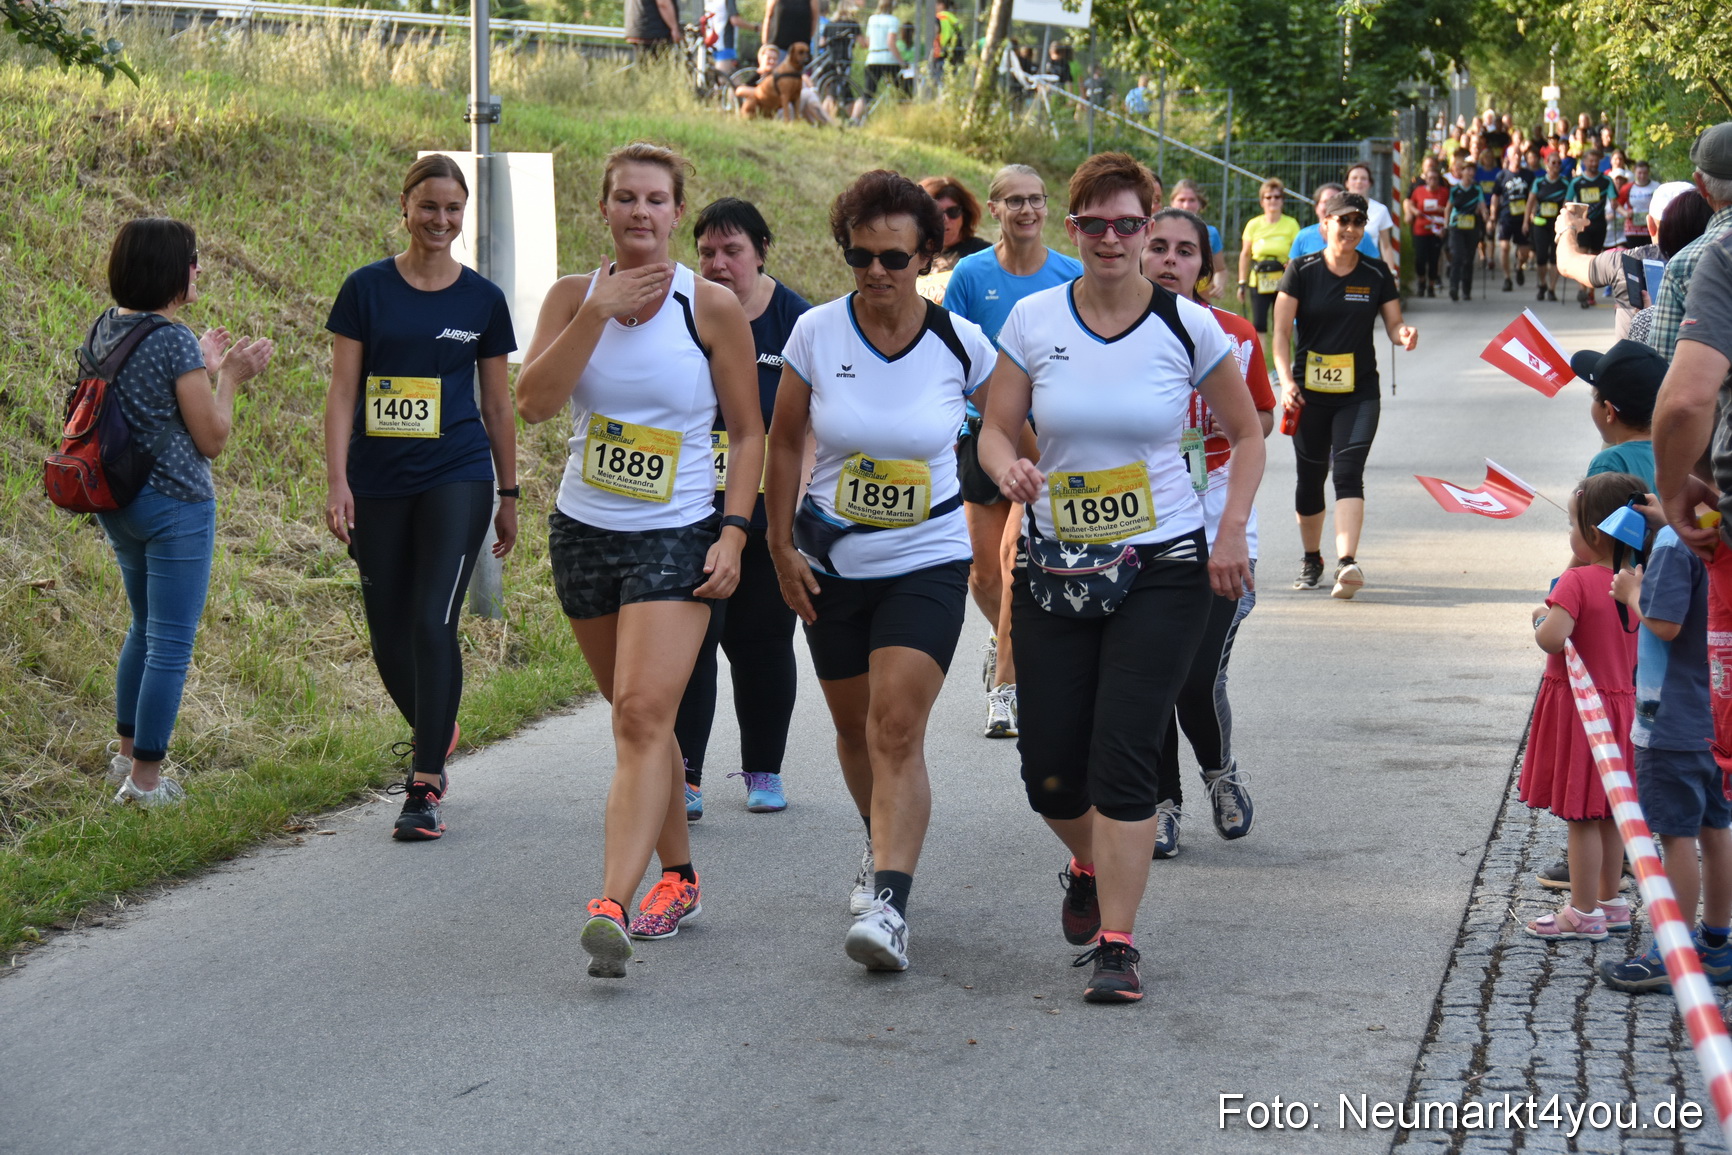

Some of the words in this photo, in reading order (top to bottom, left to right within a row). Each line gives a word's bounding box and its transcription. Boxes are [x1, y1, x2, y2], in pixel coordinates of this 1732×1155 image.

[1314, 368, 1342, 382] 142
[373, 398, 429, 420] 1403
[599, 429, 636, 446] firmenlauf
[595, 443, 664, 481] 1889
[592, 475, 605, 483] Praxis
[612, 481, 658, 495] Krankengymnastik
[597, 469, 616, 480] Meier
[617, 475, 654, 488] Alexandra
[848, 478, 915, 510] 1891
[1063, 484, 1101, 494] firmenlauf
[845, 508, 859, 516] Praxis
[868, 514, 914, 523] Krankengymnastik
[847, 502, 884, 516] Messinger
[886, 510, 914, 518] Martina
[1063, 492, 1139, 525] 1890
[1060, 523, 1118, 533] Meißner-Schulze
[1119, 516, 1150, 527] Cornelia
[1093, 525, 1142, 538] Krankengymnastik
